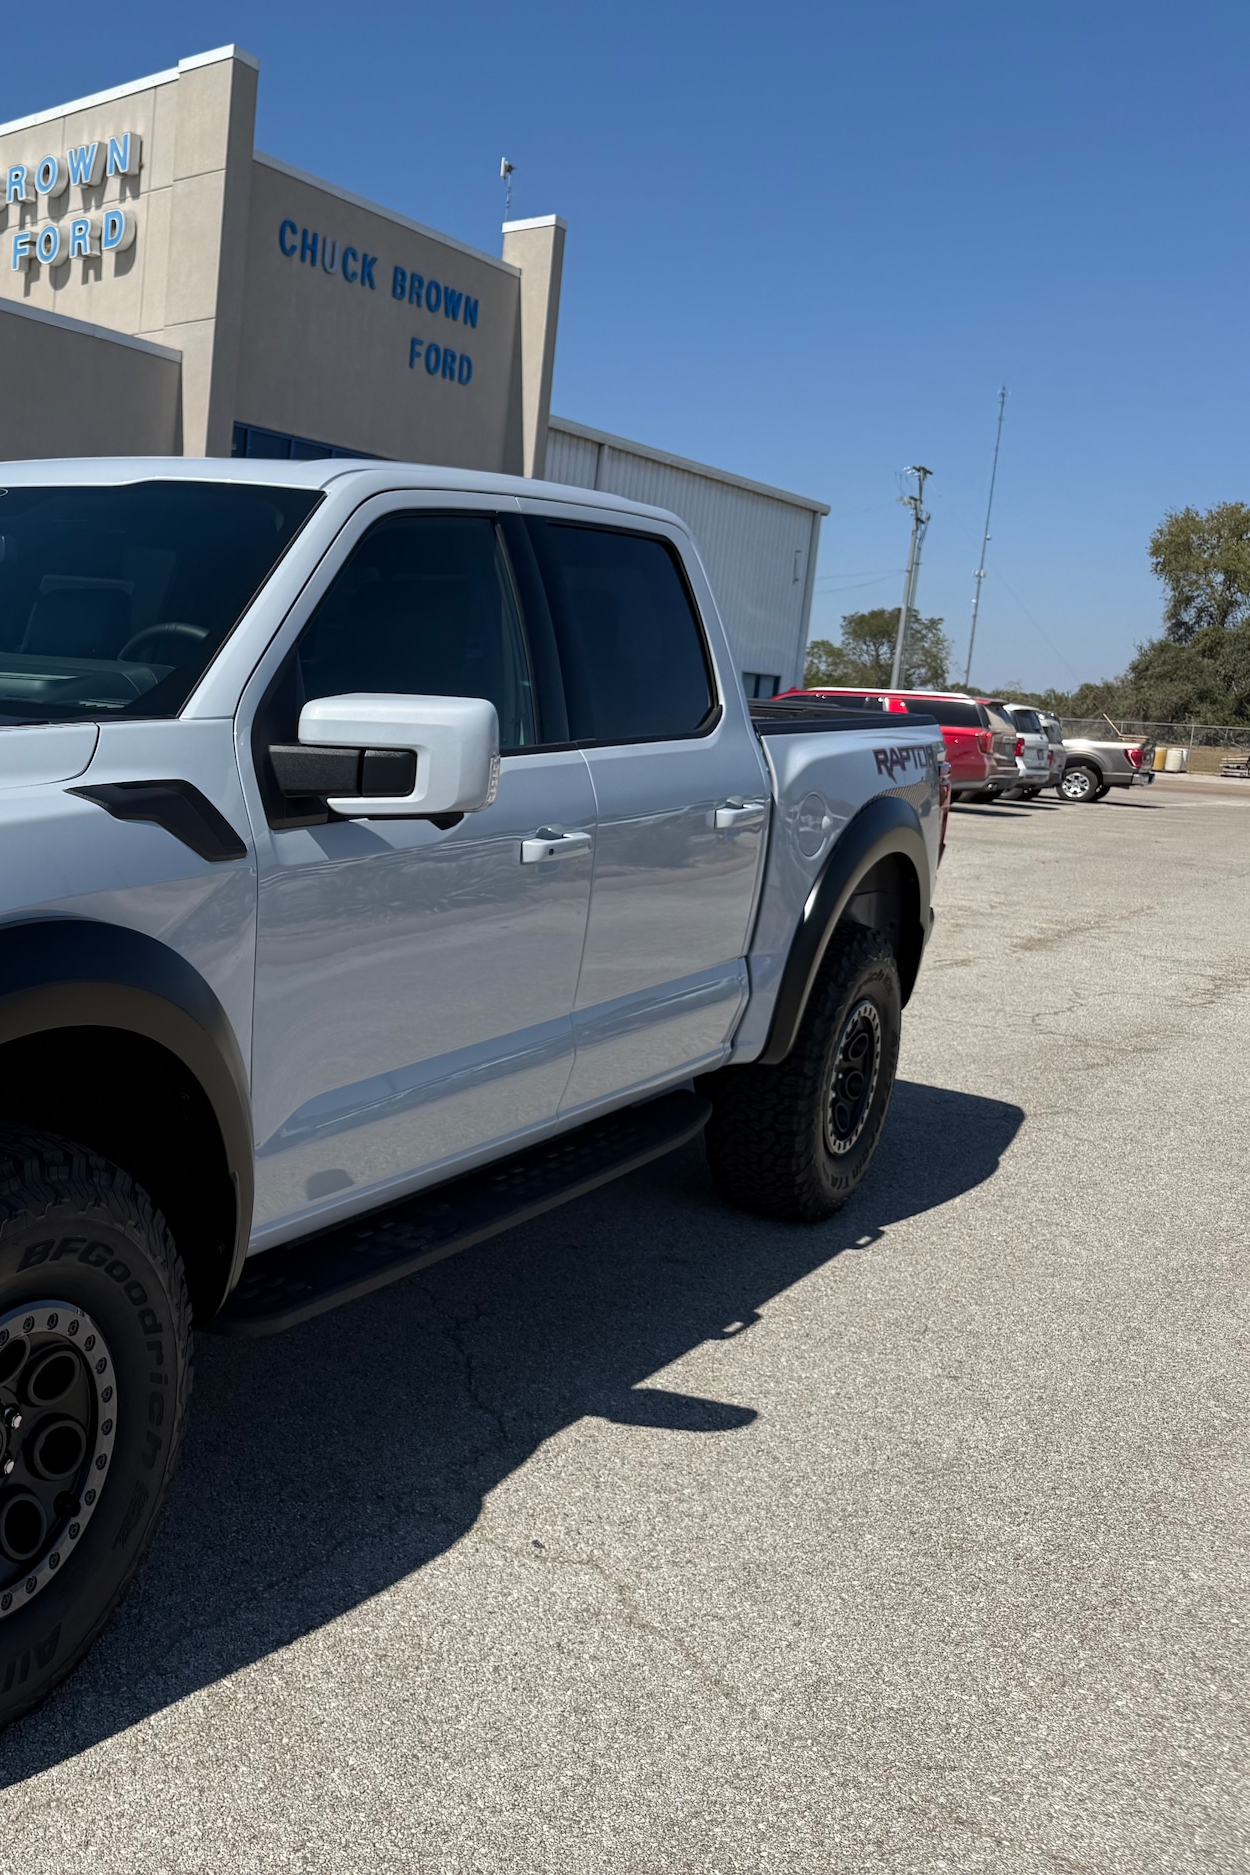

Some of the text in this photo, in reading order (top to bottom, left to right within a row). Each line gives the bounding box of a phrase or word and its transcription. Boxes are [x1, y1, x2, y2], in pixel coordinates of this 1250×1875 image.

[11, 208, 134, 273] FORD
[278, 218, 479, 329] CHUCK BROWN
[408, 336, 473, 386] FORD
[872, 743, 937, 785] RAPTOR
[16, 1236, 169, 1470] BFGoodrich
